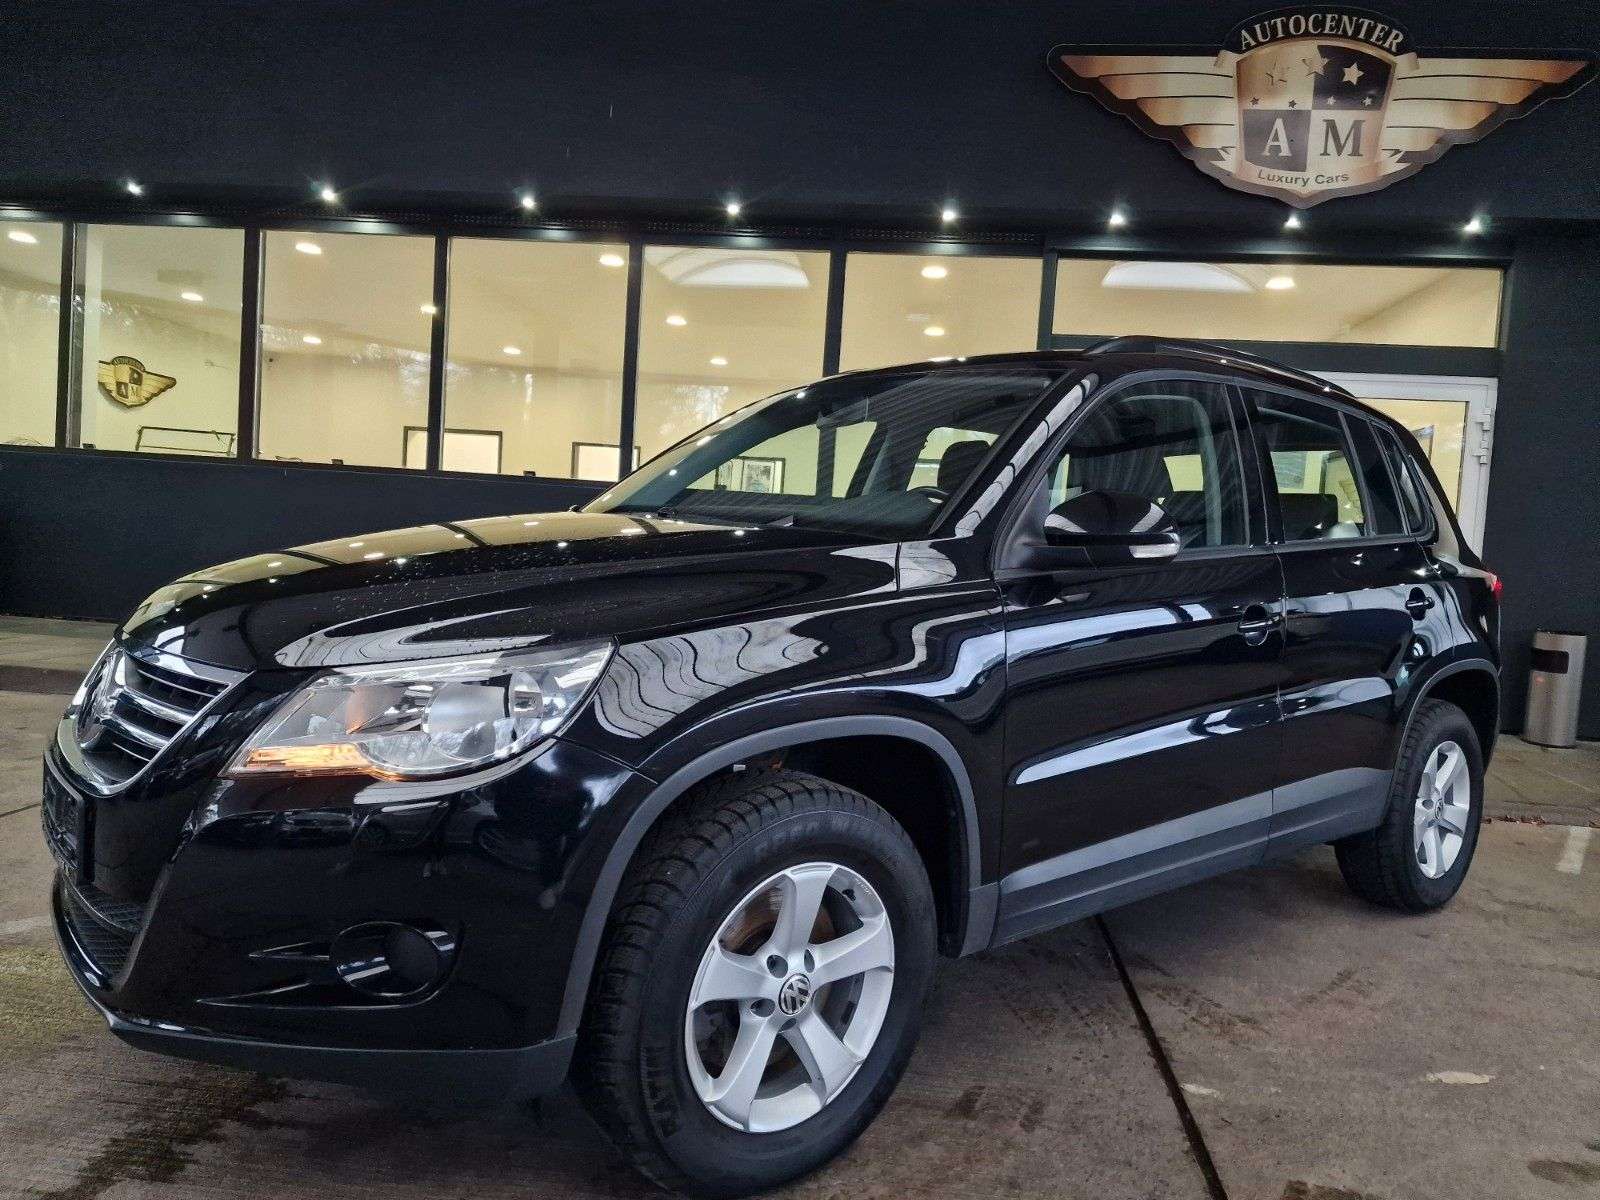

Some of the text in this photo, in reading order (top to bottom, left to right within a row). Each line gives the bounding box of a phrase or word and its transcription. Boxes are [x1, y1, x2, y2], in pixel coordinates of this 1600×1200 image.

[1240, 13, 1404, 52] AUTOCENTER
[1261, 118, 1366, 157] A M
[1257, 169, 1350, 187] Luxury Cars
